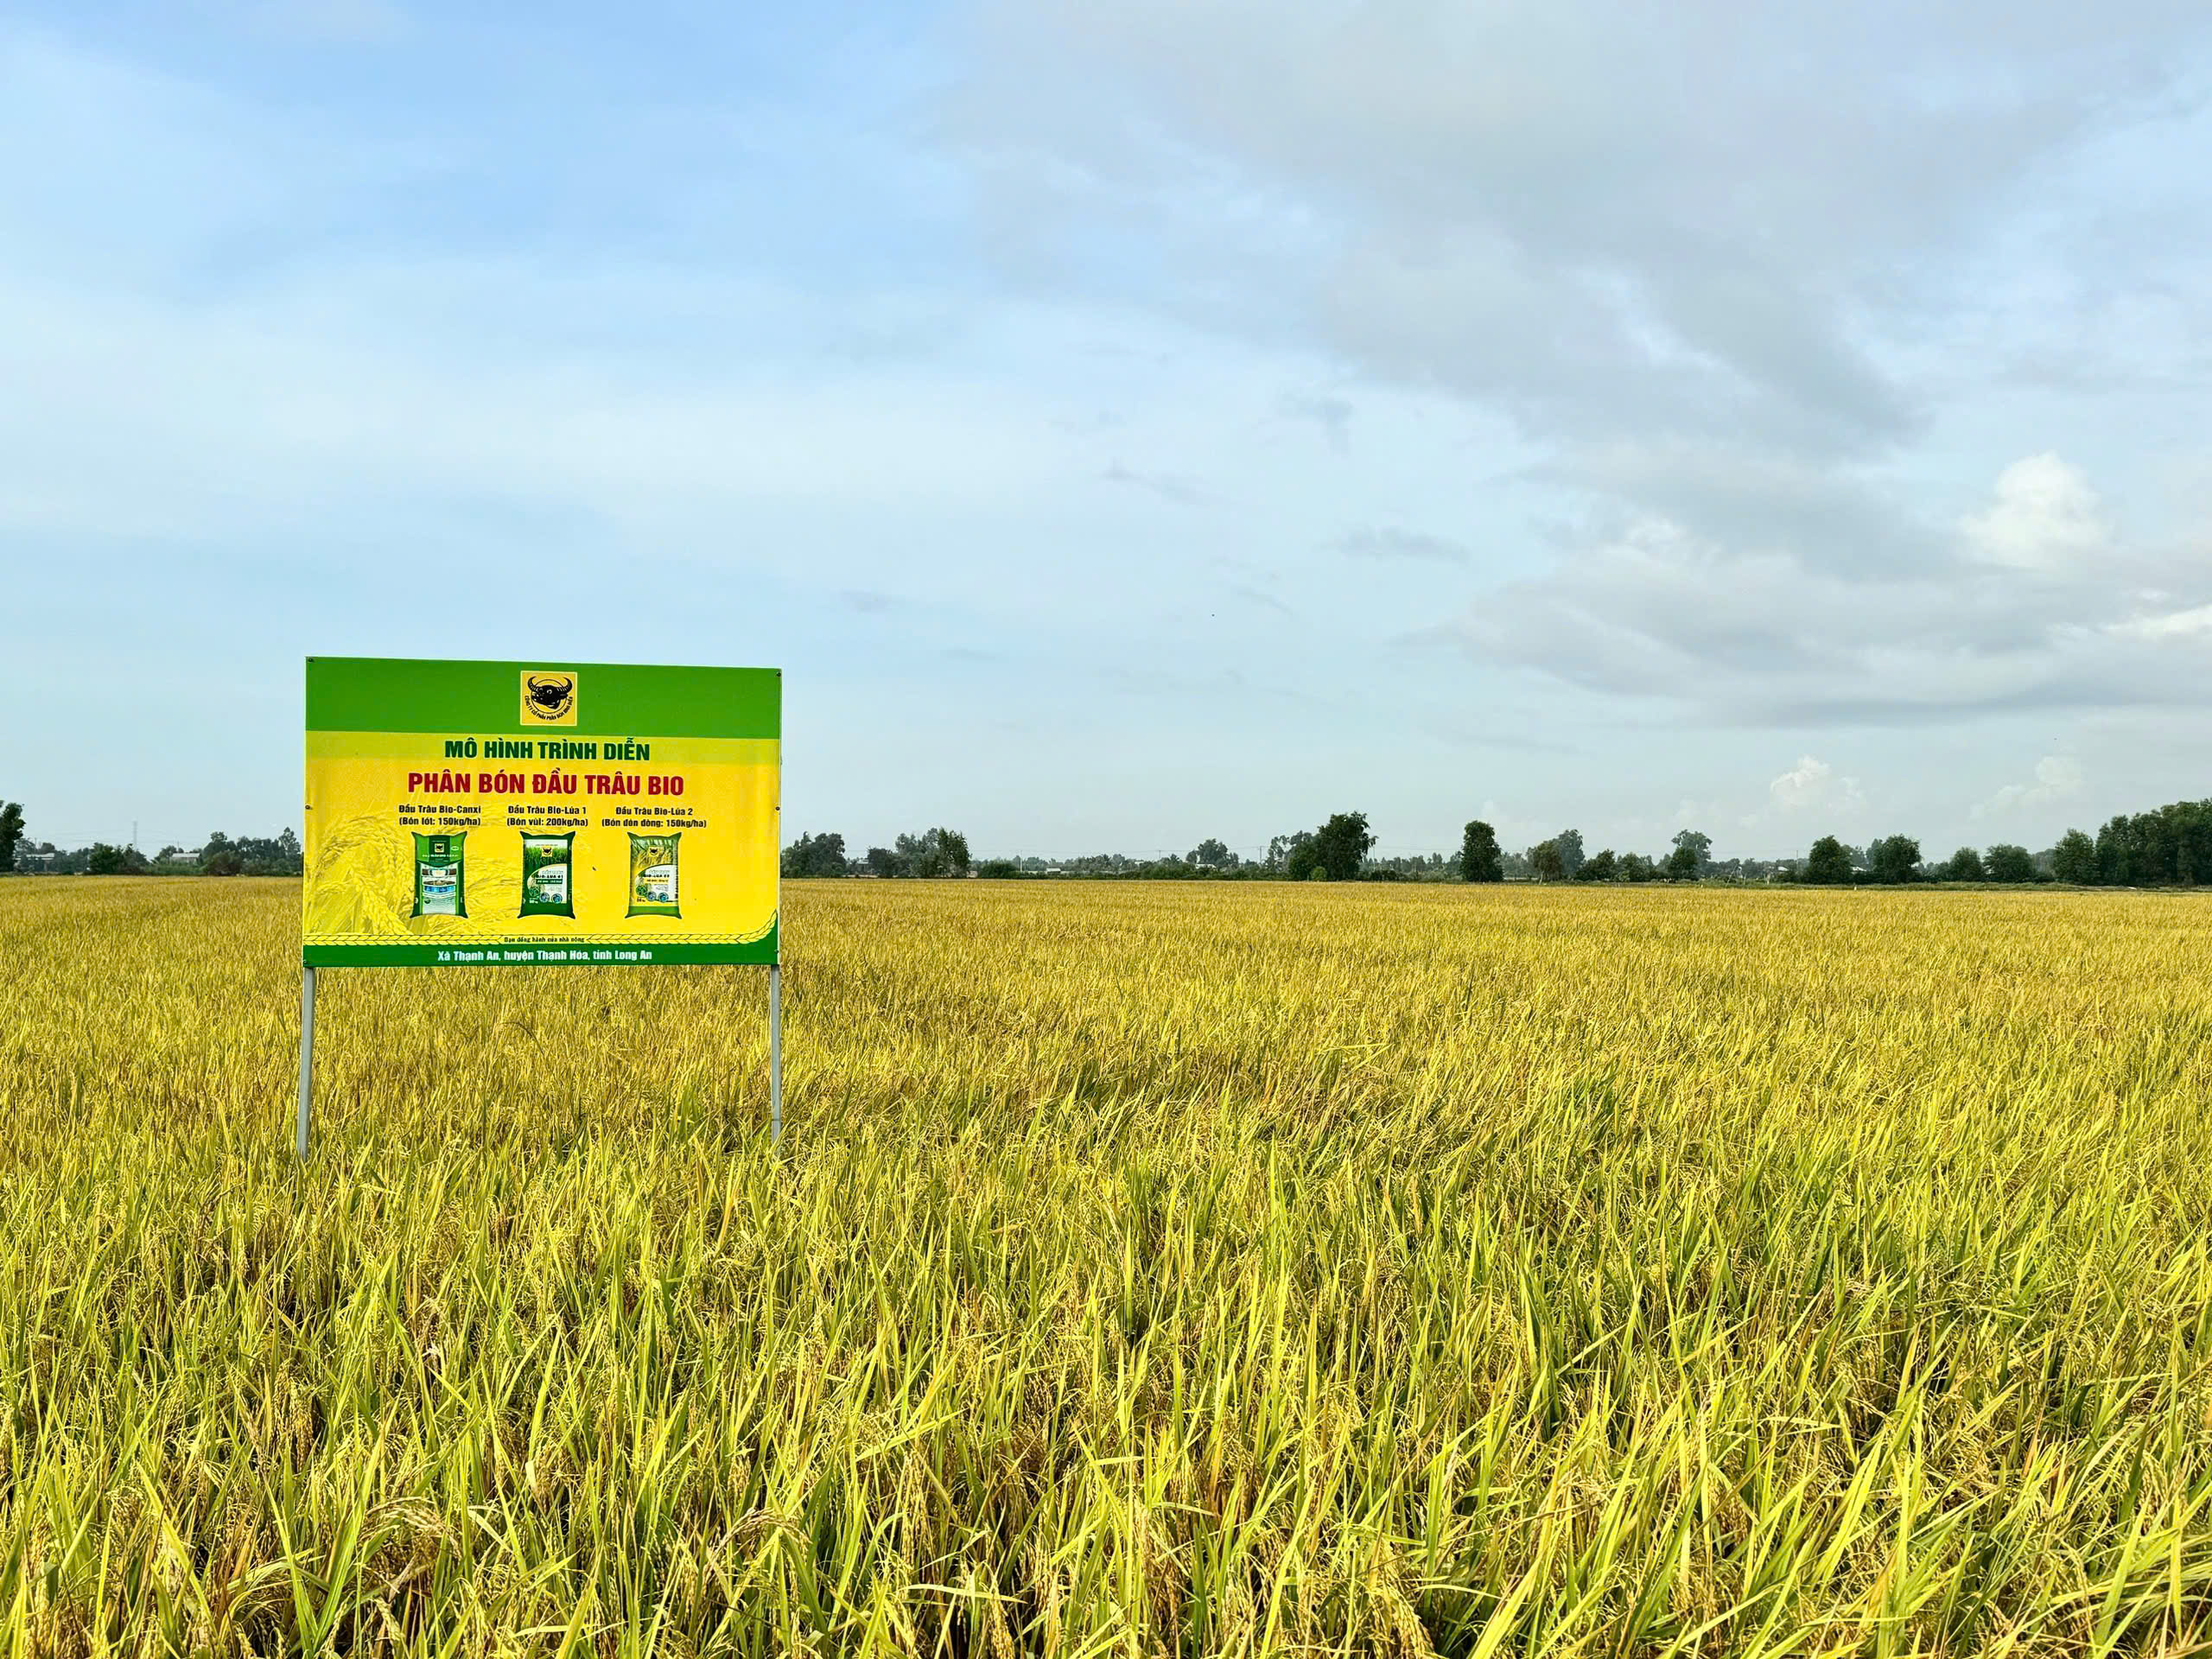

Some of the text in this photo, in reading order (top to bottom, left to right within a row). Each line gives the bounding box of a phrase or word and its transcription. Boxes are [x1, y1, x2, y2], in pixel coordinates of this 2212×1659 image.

[445, 737, 651, 761] MÔ HÌNH TRÌNH DIỄN
[408, 767, 684, 796] PHÂN BÓN ĐẦU TRÂU BIO
[418, 804, 437, 813] Trâu
[439, 804, 481, 814] Bio-Canxi
[527, 804, 545, 814] Trâu
[547, 805, 580, 815] Bio-Lúa
[582, 806, 587, 815] 1
[634, 806, 652, 815] Trâu
[654, 806, 685, 816] Bio-Lúa
[399, 817, 419, 826] (Bón
[438, 817, 481, 826] 150kg/ha)
[506, 817, 526, 827] (Bón
[546, 818, 588, 827] 200kg/ha)
[601, 818, 620, 828] (Bón
[666, 819, 707, 829] 150kg/ha)
[437, 950, 451, 961] Xã
[454, 950, 484, 963] Thạnh
[486, 951, 501, 962] An,
[504, 950, 534, 962] huyện
[537, 950, 567, 963] Thạnh
[593, 950, 613, 960] tỉnh
[614, 950, 638, 962] Long
[639, 950, 652, 960] An
